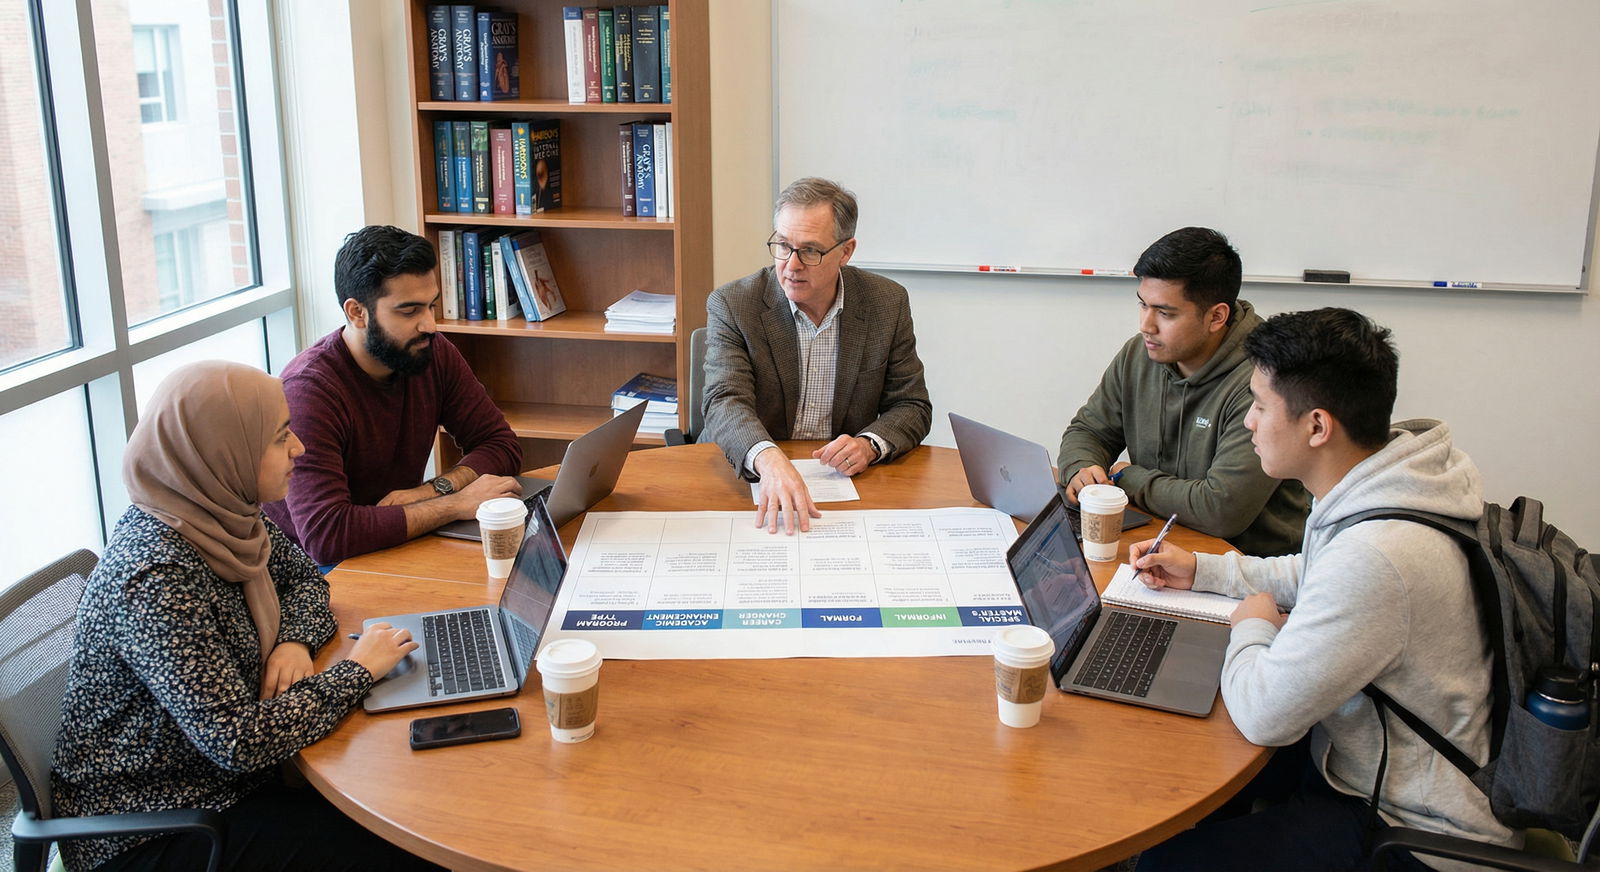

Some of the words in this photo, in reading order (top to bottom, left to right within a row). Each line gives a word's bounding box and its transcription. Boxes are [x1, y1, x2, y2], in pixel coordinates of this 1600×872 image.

[430, 29, 439, 70] ANATOMY
[438, 28, 448, 62] GRAY'S
[455, 29, 464, 70] ANATOMY
[463, 28, 472, 62] GRAY'S
[894, 613, 946, 621] INFORMAL
